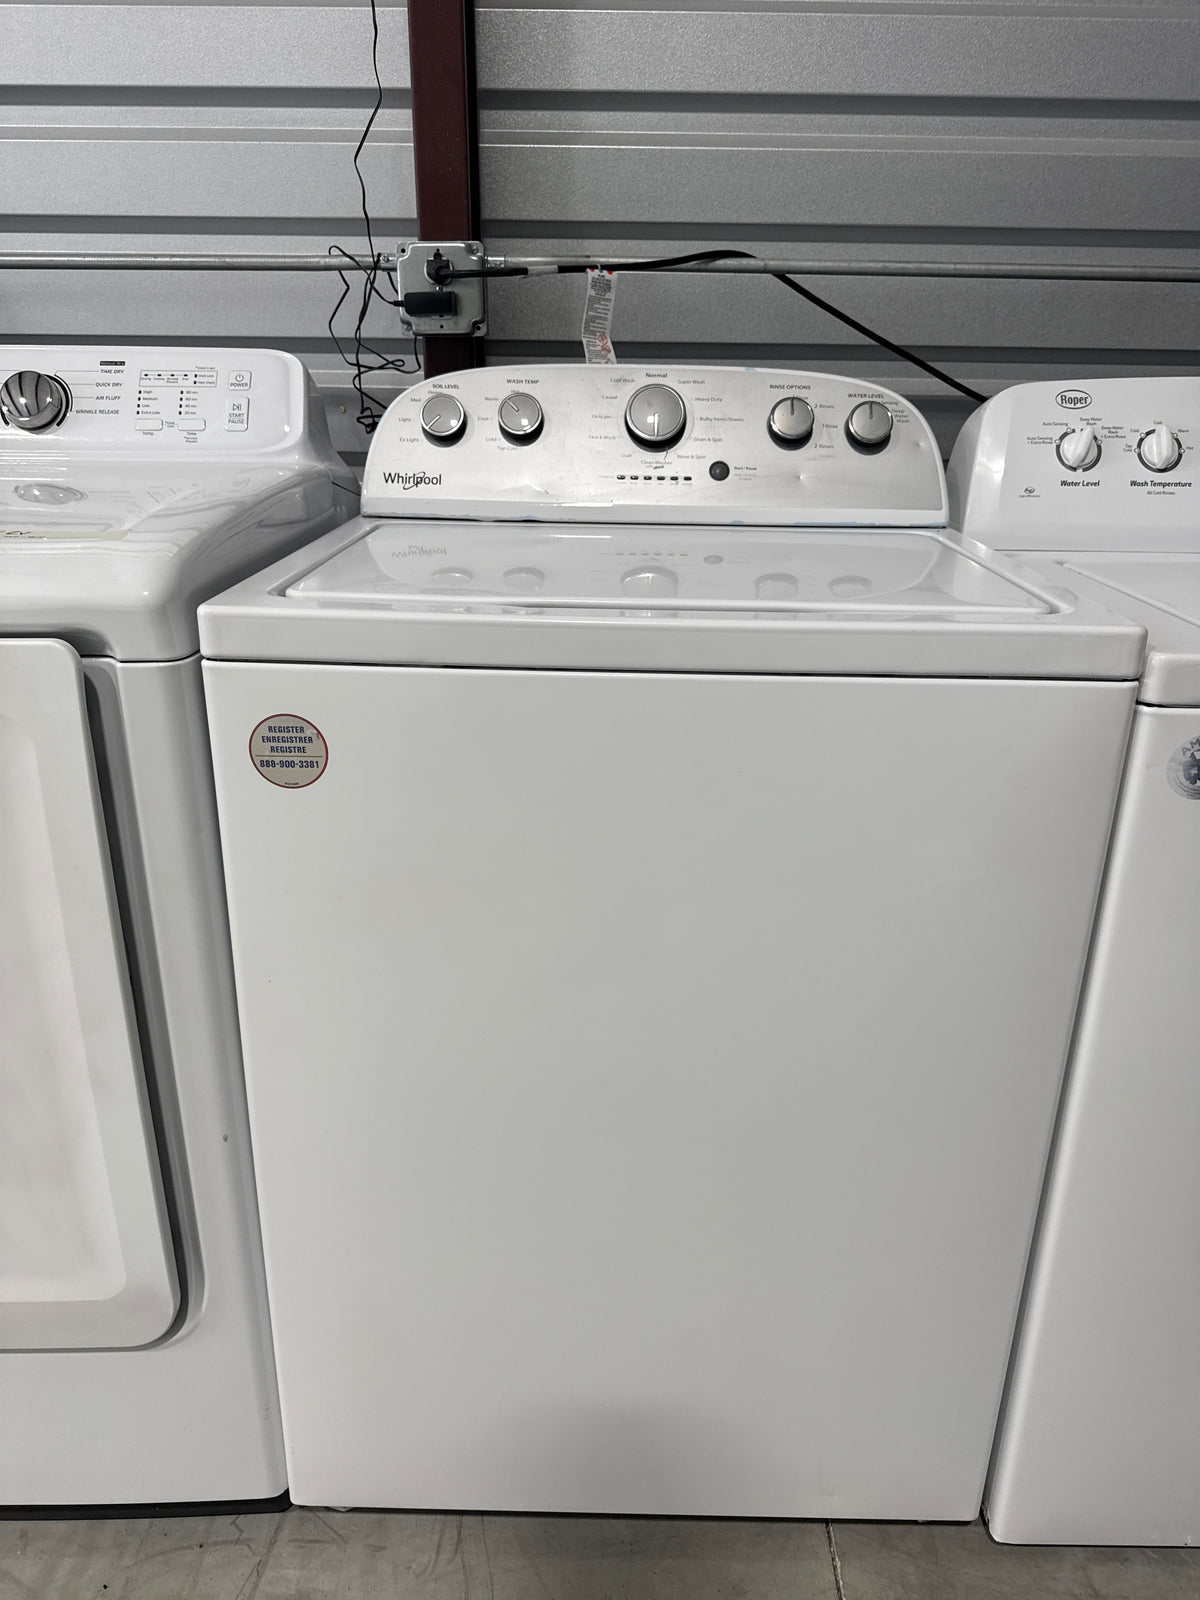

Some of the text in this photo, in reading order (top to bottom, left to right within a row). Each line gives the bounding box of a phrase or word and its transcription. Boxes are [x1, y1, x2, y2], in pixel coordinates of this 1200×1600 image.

[1060, 394, 1088, 406] Roper
[383, 472, 442, 490] Whirlpool
[260, 760, 319, 768] 888-900-3381
